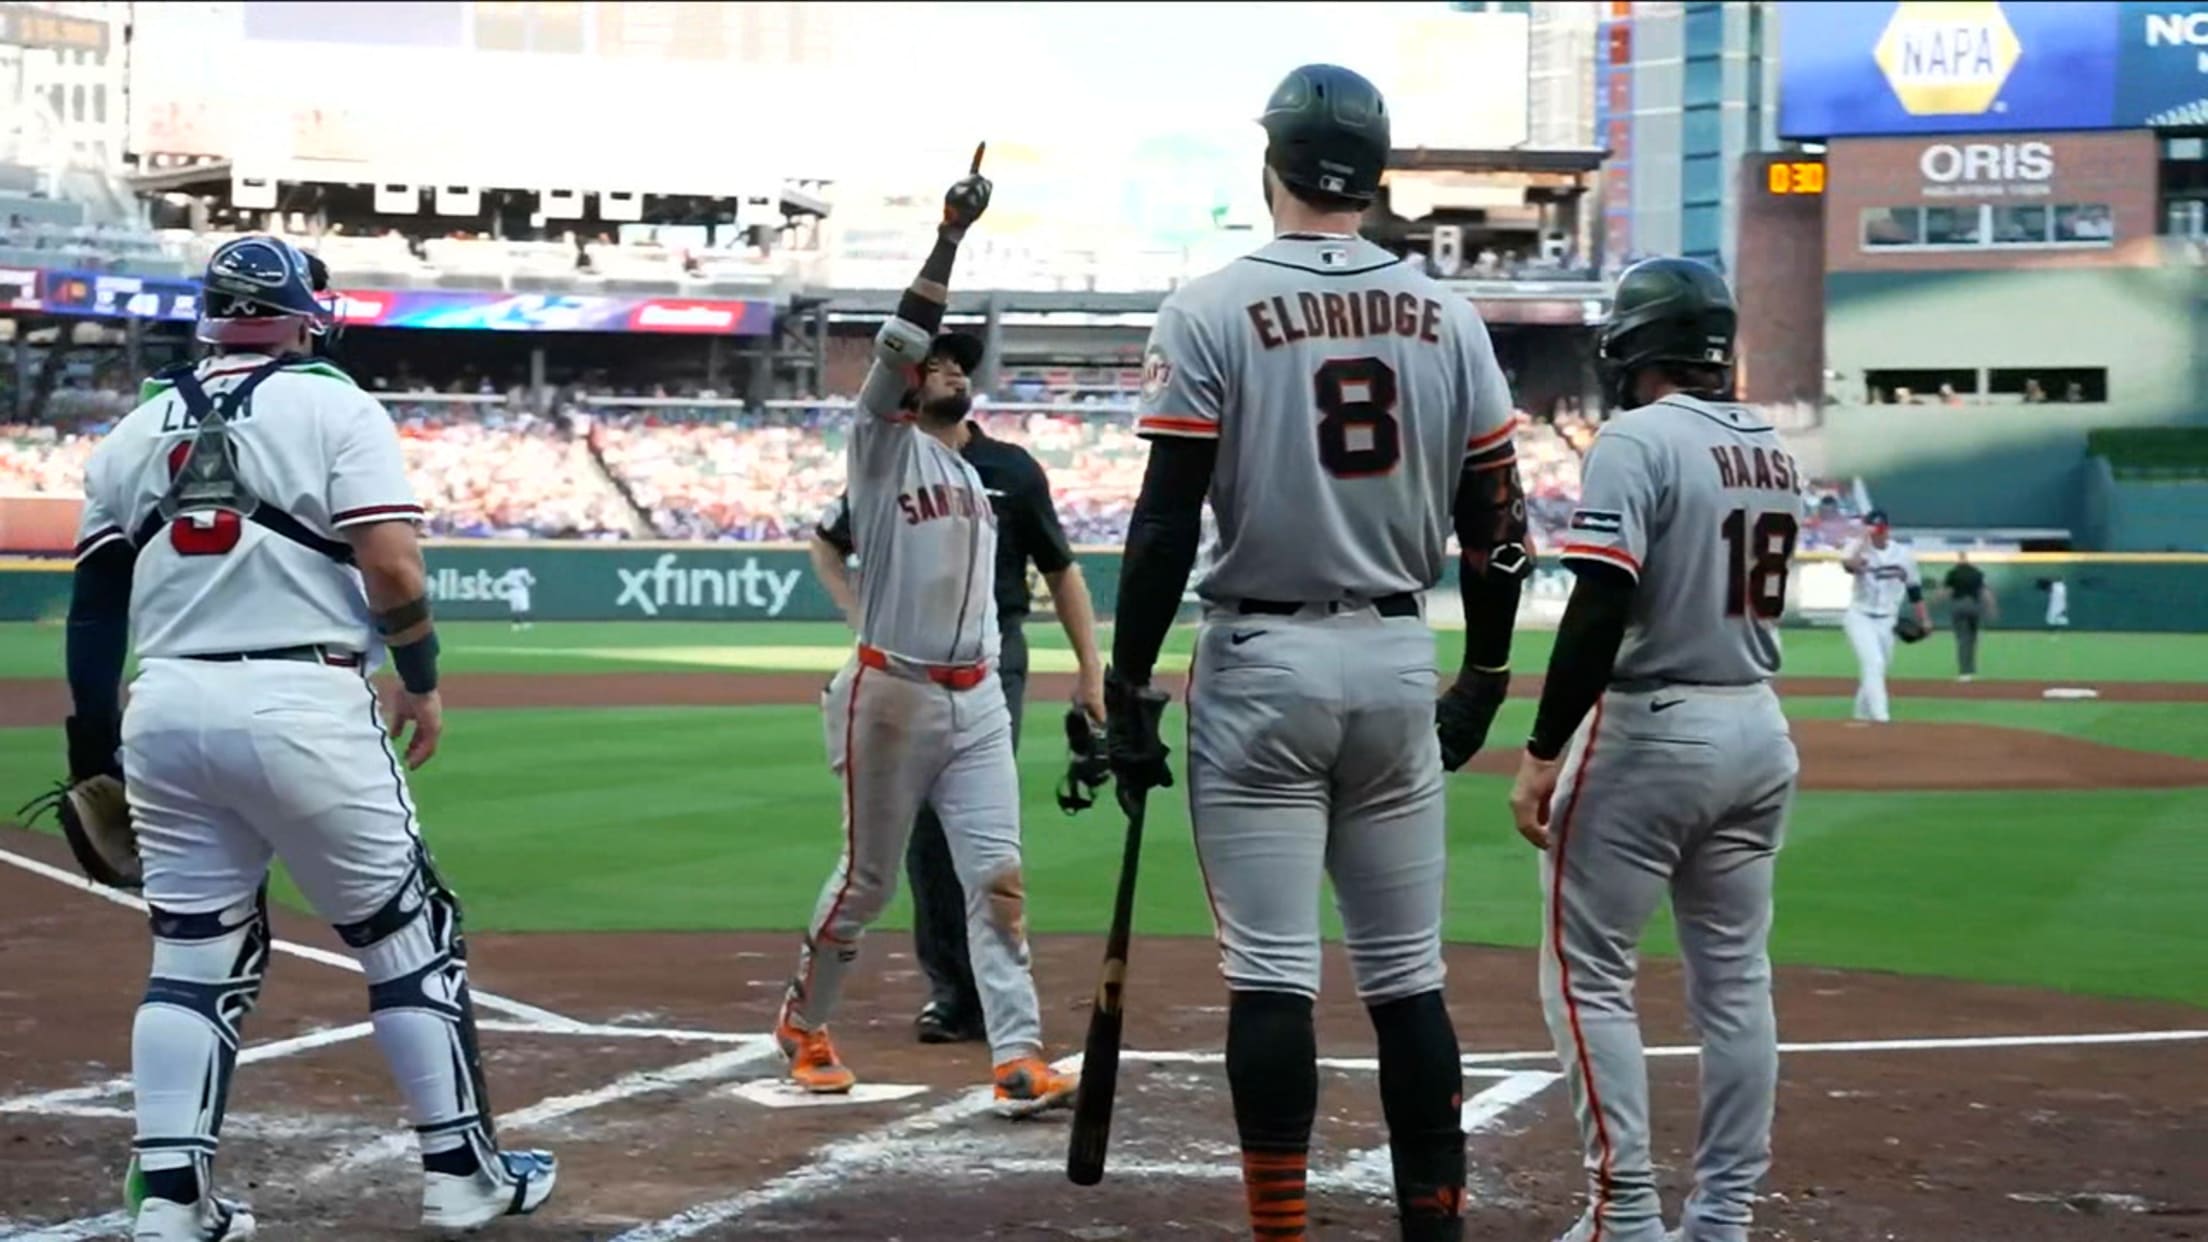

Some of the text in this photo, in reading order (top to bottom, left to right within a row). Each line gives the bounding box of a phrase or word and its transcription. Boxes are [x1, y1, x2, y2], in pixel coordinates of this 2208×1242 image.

[1903, 27, 1993, 76] NAPA
[1920, 141, 2054, 182] ORIS
[1246, 289, 1441, 350] ELDRIDGE
[1314, 357, 1400, 479] 8
[616, 552, 802, 616] xfinity
[1721, 508, 1798, 619] 18
